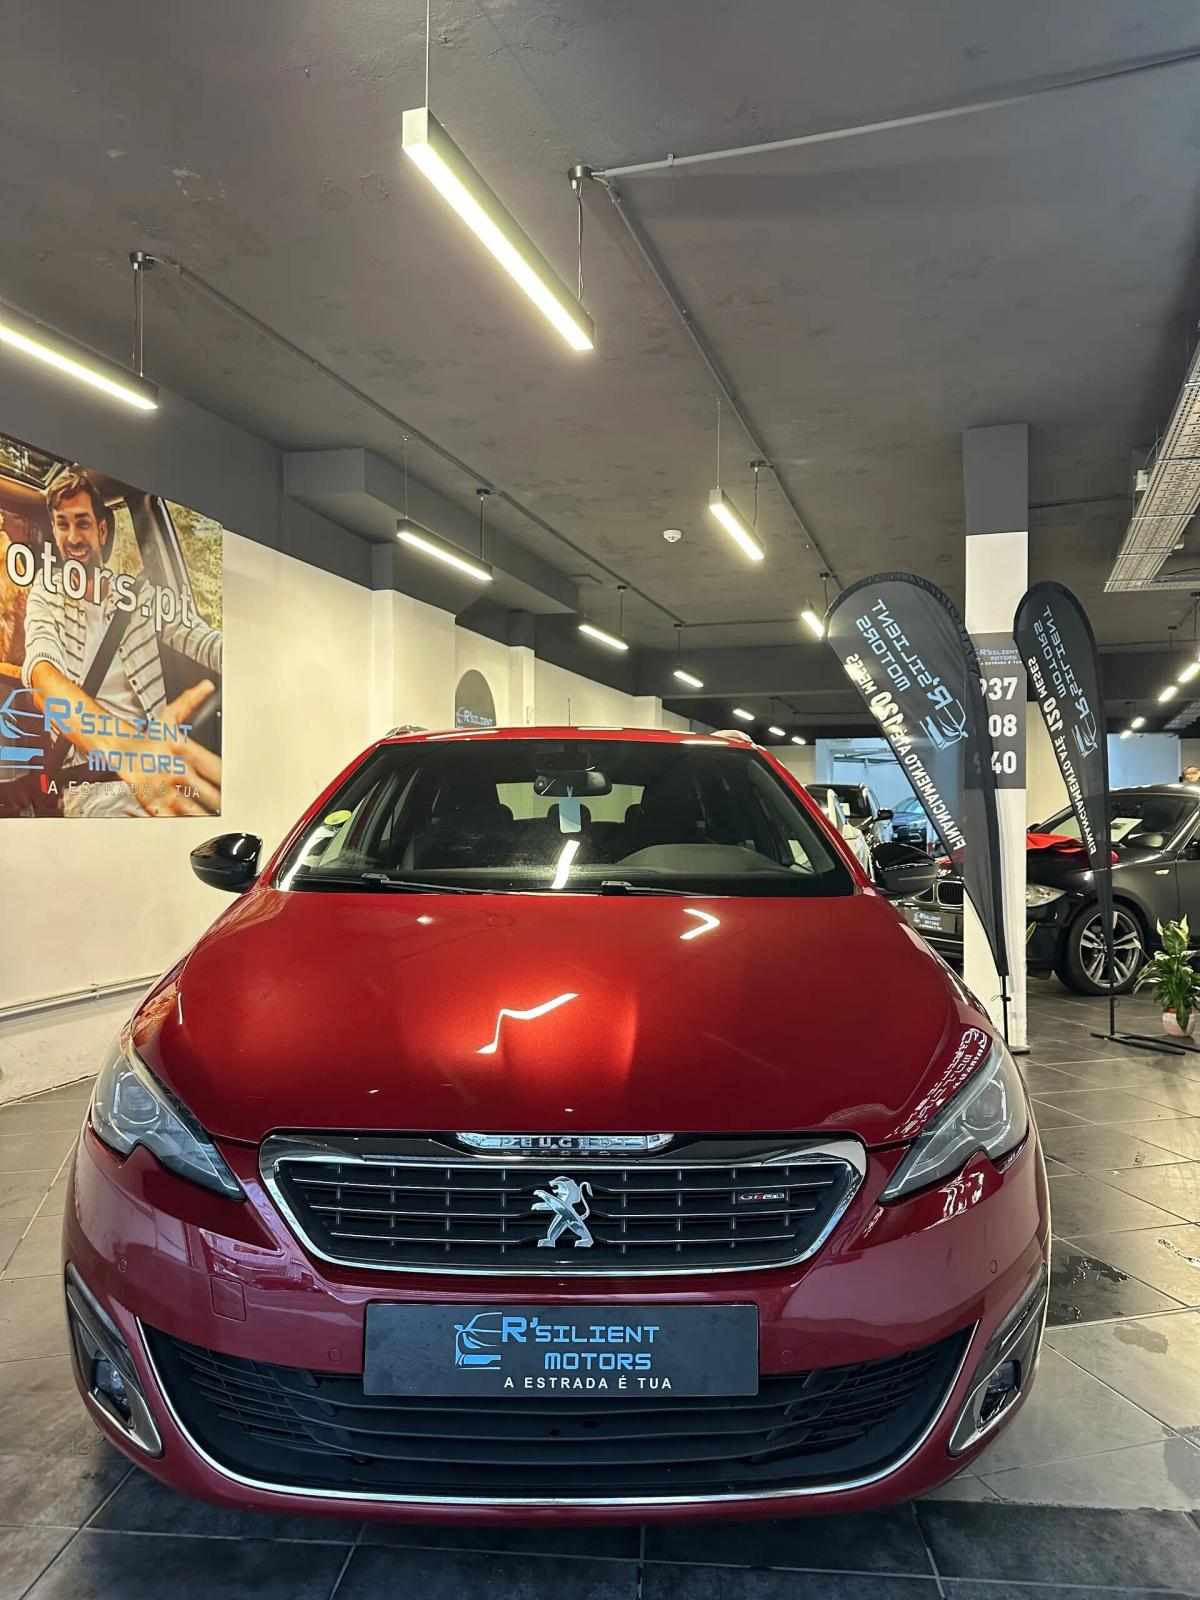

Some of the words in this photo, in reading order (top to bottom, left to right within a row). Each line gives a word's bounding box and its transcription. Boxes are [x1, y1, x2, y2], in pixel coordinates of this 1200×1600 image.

[44, 697, 192, 744] R'SILIENT
[88, 749, 187, 774] MOTORS
[47, 780, 58, 796] A
[502, 1316, 659, 1343] R'SILIENT
[545, 1352, 652, 1370] MOTORS
[504, 1377, 514, 1389] A
[524, 1377, 608, 1389] ESTRADA
[618, 1375, 629, 1389] É
[637, 1377, 672, 1389] TUA
